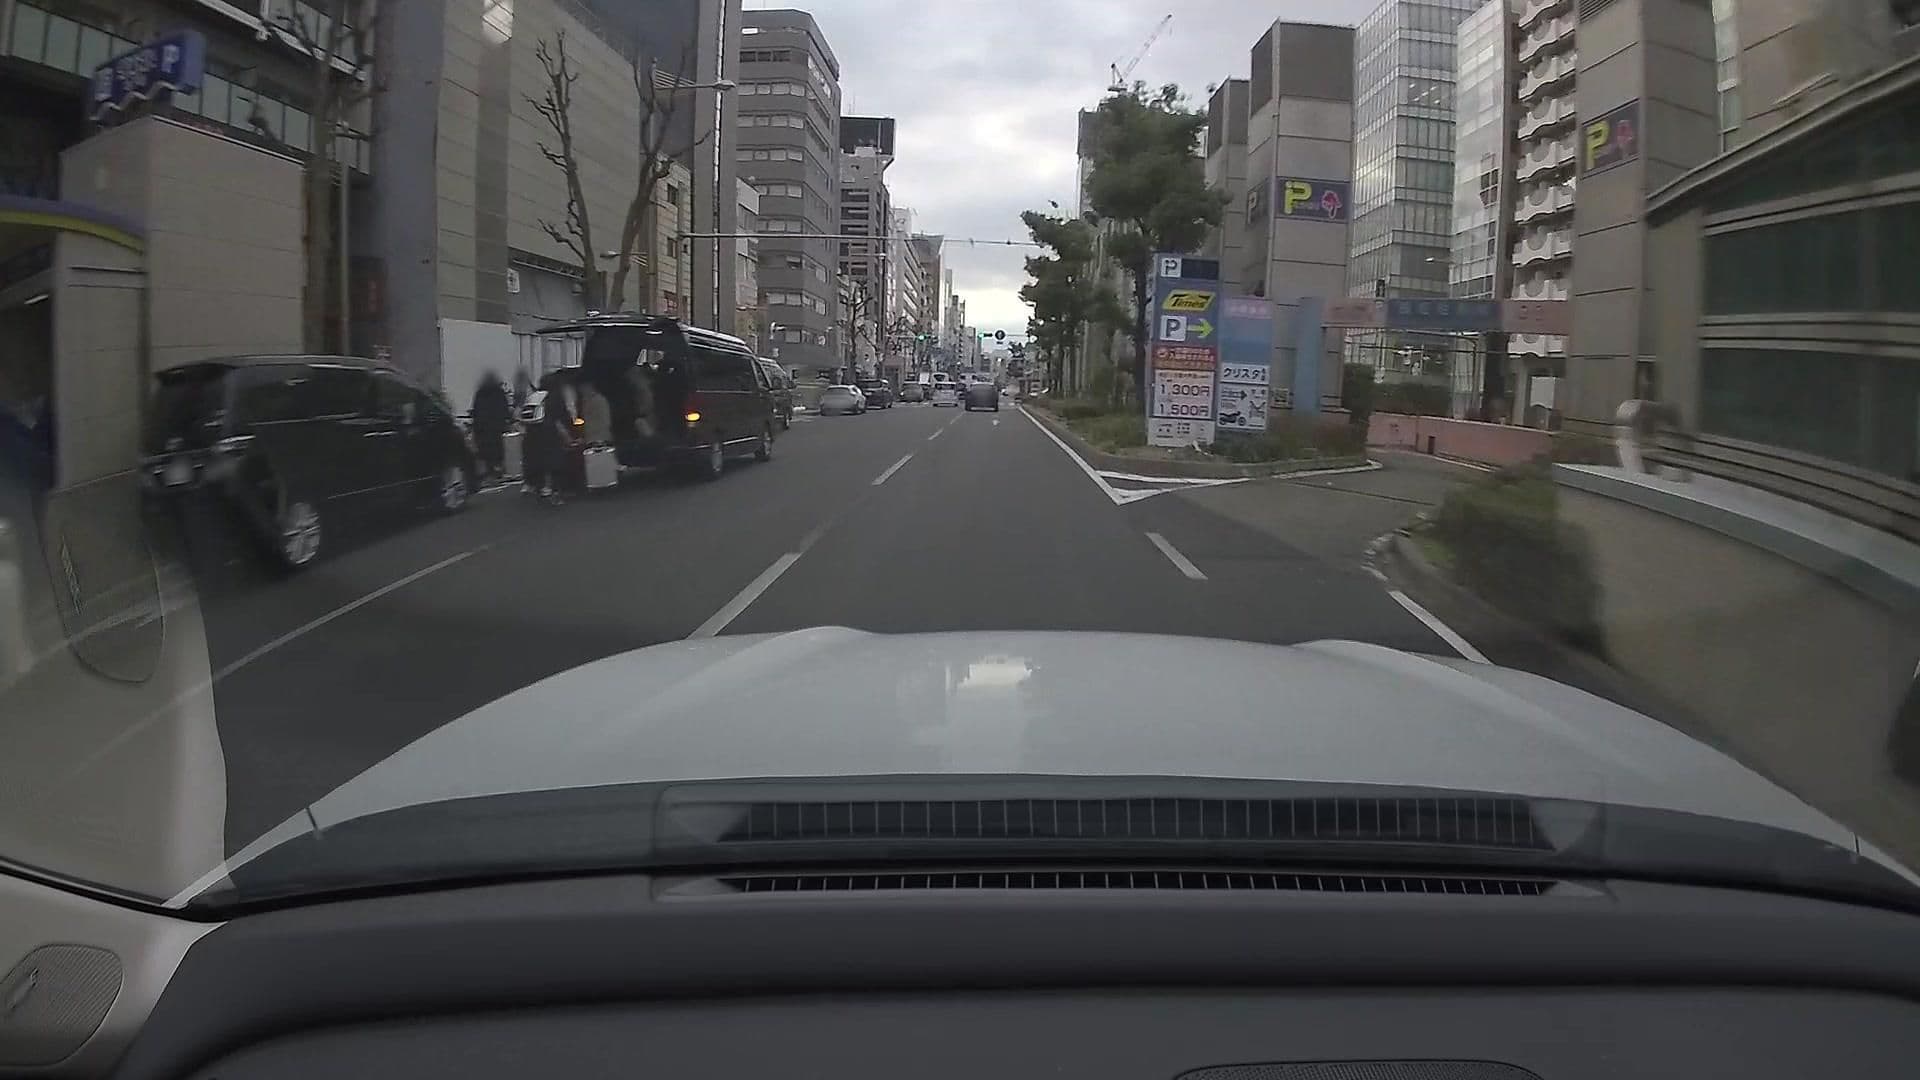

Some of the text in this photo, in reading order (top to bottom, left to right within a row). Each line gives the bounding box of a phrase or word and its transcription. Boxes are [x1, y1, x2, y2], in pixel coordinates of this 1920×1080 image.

[1586, 120, 1609, 169] P
[1284, 181, 1312, 215] P
[1169, 293, 1212, 308] Times
[1166, 318, 1181, 337] P
